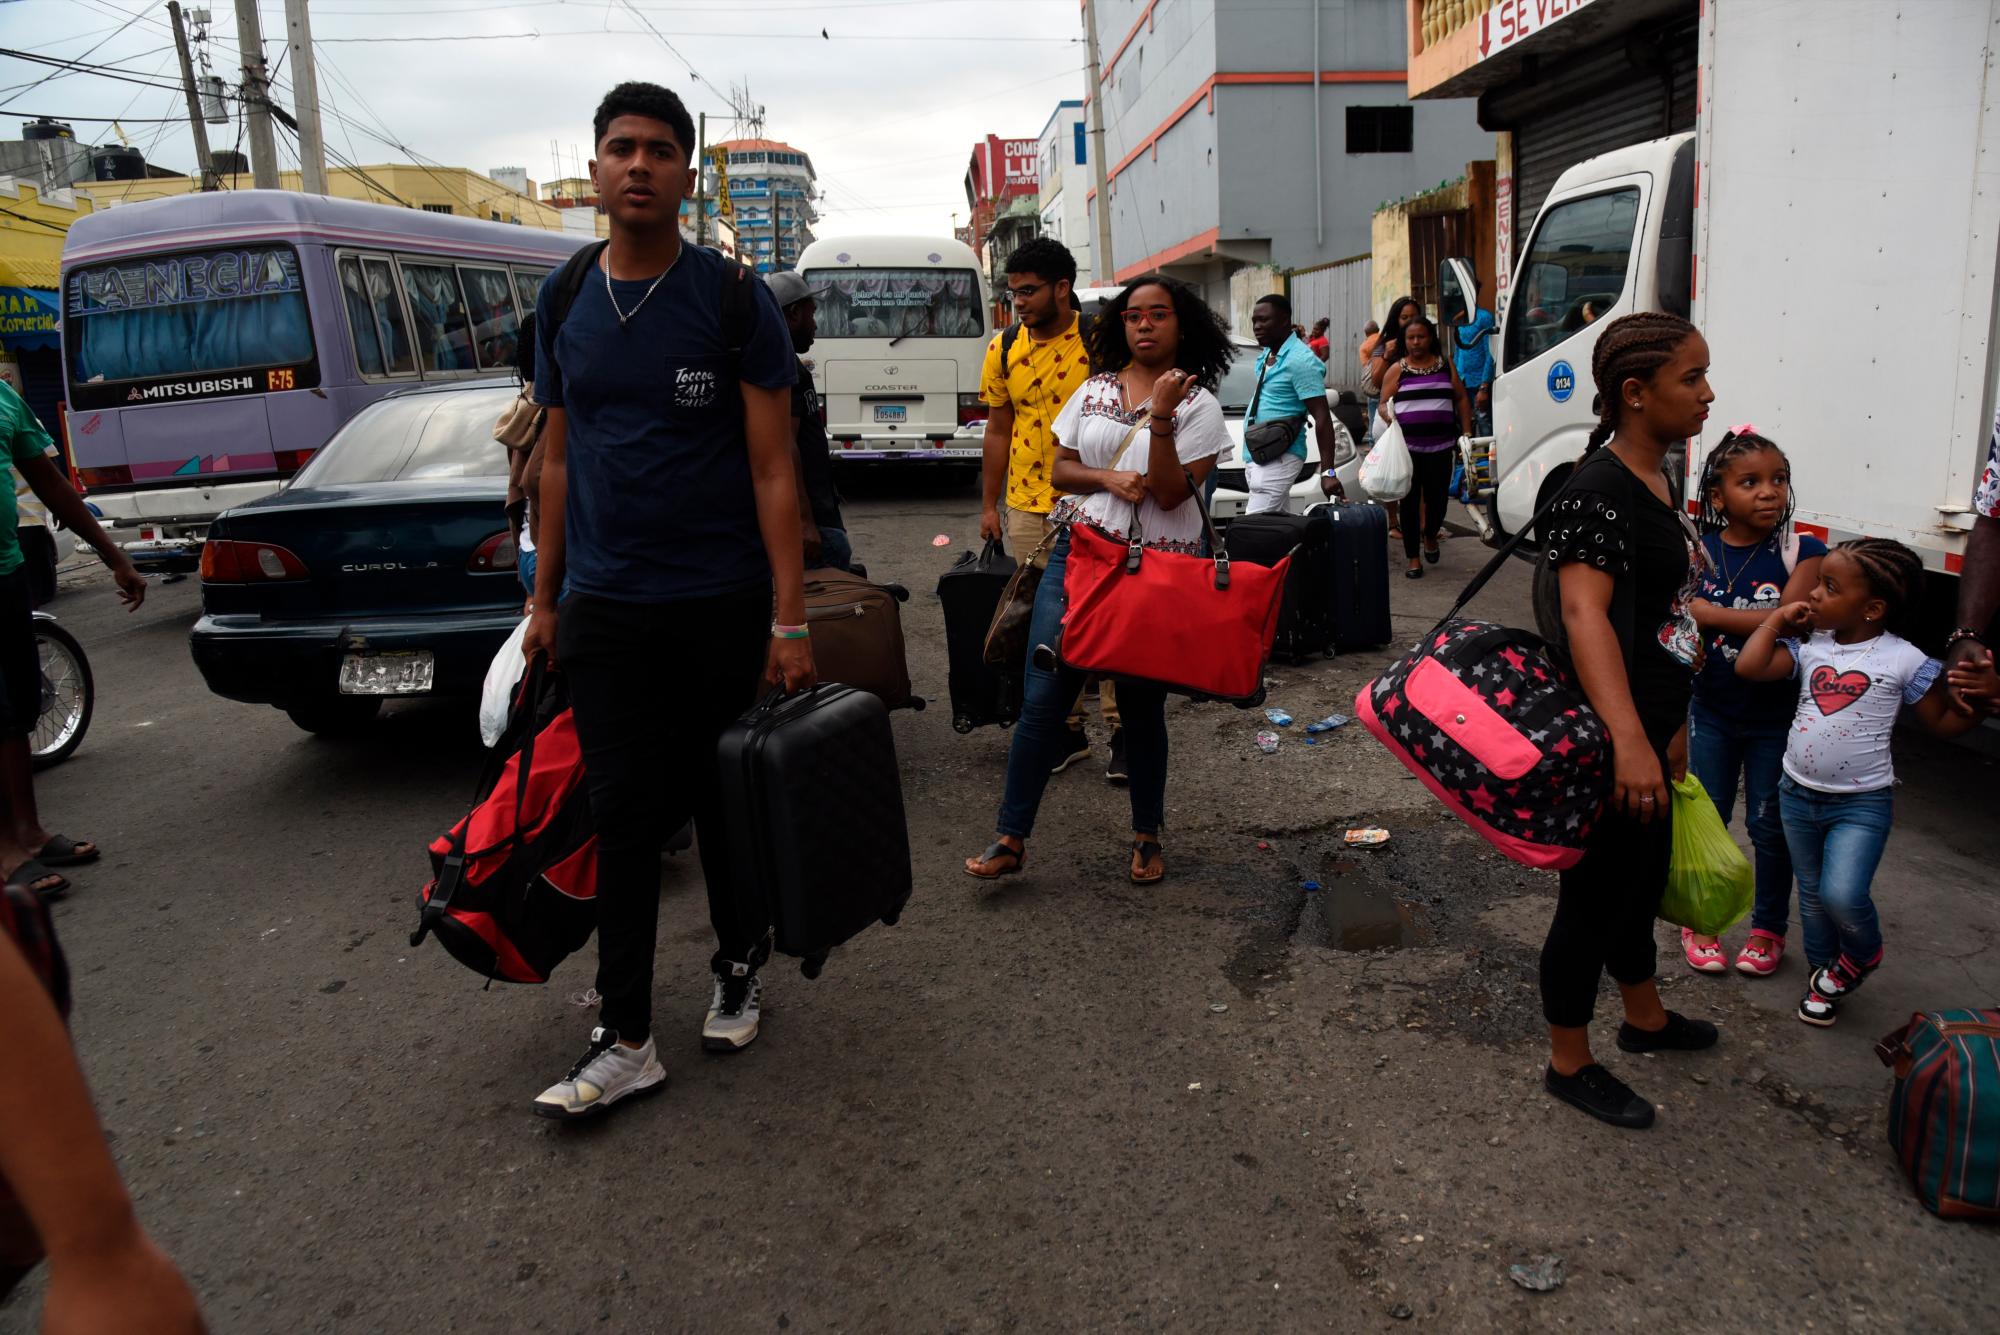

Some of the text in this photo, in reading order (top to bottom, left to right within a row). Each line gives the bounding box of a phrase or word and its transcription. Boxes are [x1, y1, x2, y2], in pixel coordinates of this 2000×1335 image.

[1500, 0, 1529, 45] SE
[79, 250, 292, 314] LA NECIA
[143, 376, 253, 399] MITSUBISHI
[268, 369, 294, 390] F-75
[1555, 376, 1571, 390] 0134
